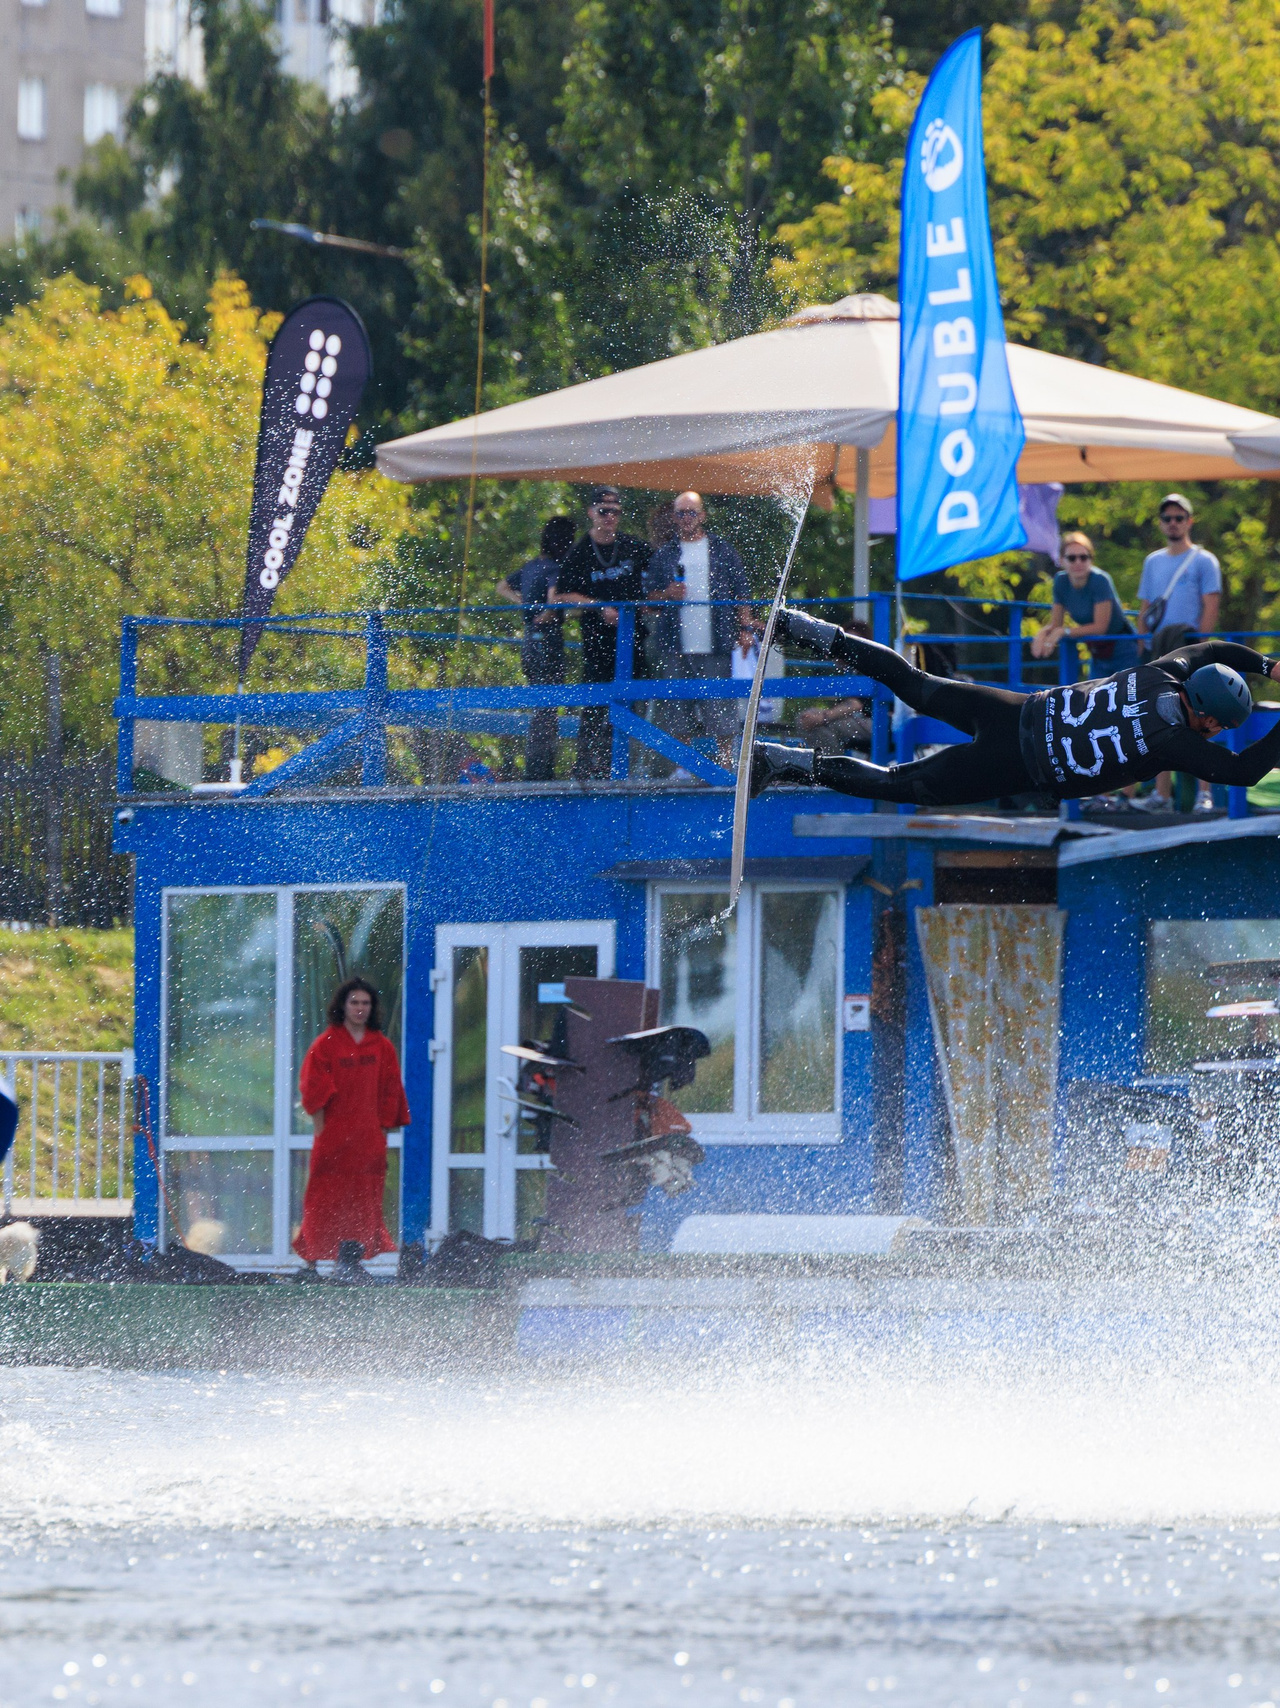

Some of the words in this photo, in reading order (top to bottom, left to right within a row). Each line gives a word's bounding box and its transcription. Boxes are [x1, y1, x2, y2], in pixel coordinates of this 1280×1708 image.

[926, 216, 980, 536] DOUBLE
[259, 512, 295, 590] COOL
[277, 428, 314, 508] ZONE
[1060, 681, 1129, 778] 55
[1131, 718, 1142, 739] WAKE
